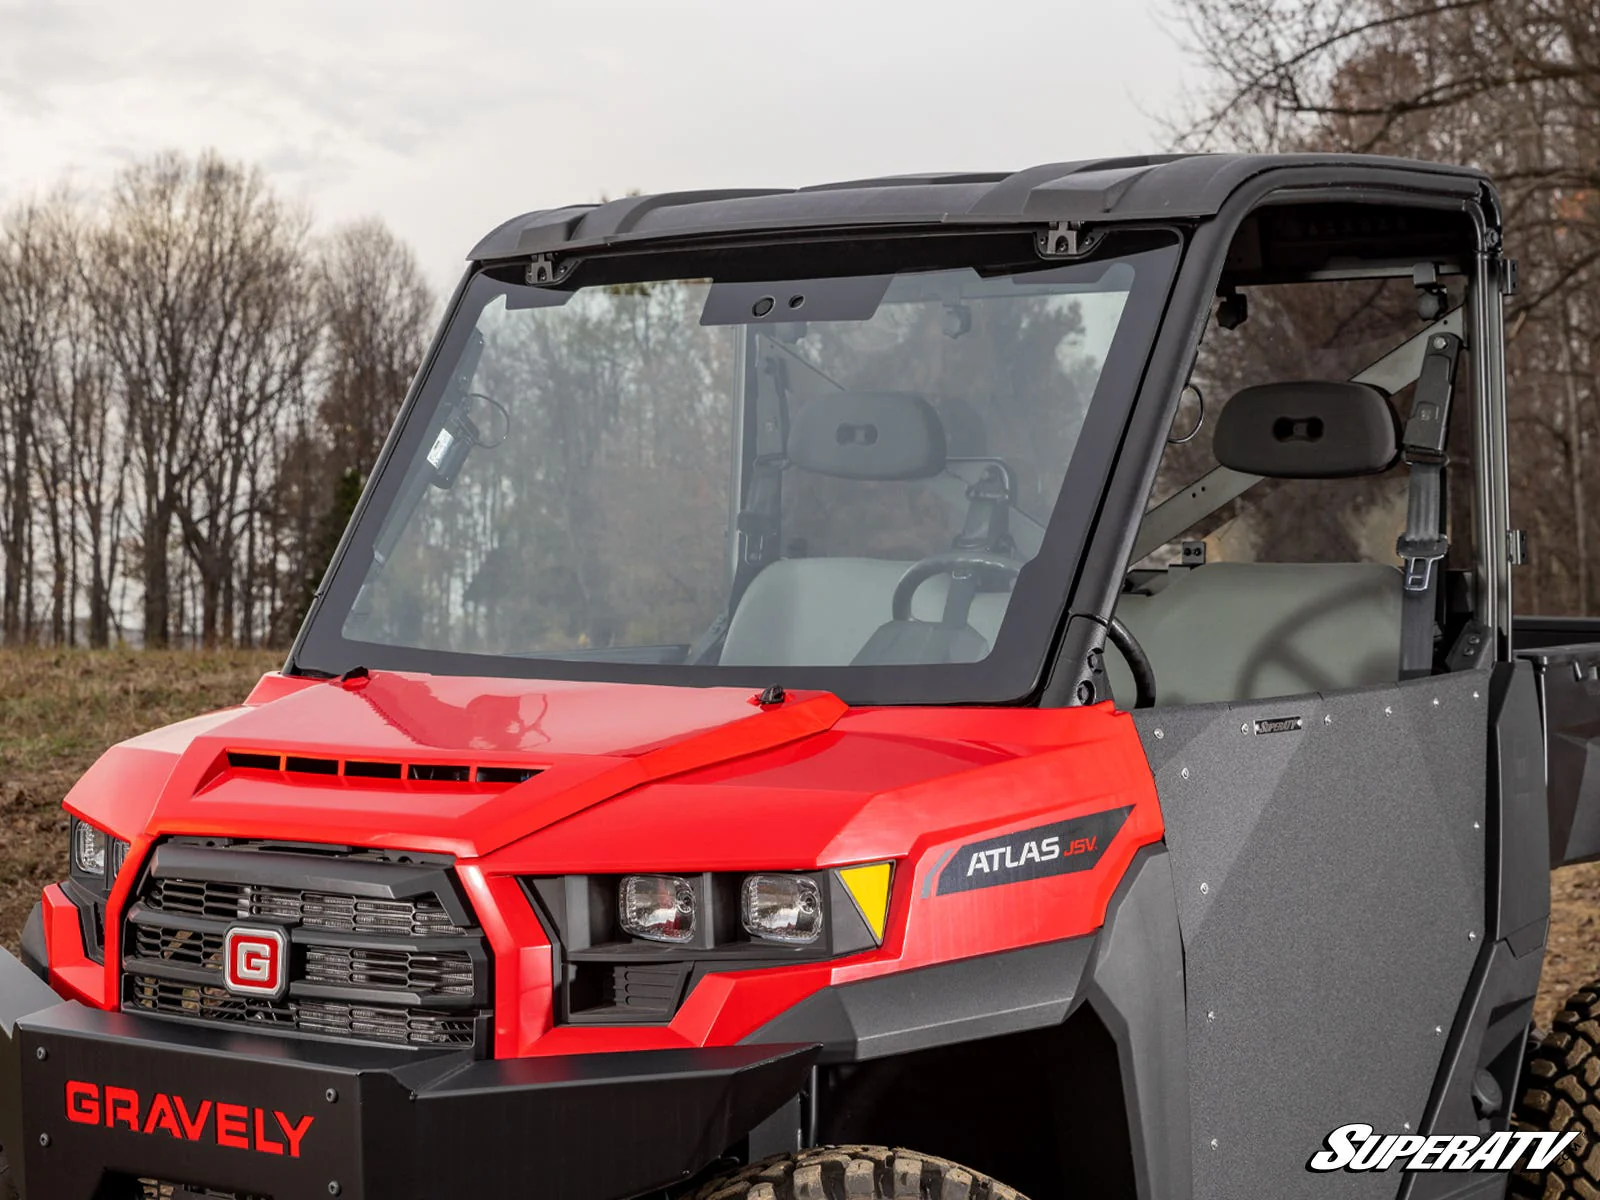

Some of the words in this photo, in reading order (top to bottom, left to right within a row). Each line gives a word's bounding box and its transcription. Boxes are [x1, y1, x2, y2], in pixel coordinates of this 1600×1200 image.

[966, 836, 1060, 877] ATLAS
[1063, 835, 1097, 857] JSV
[237, 941, 271, 982] G
[65, 1079, 315, 1158] GRAVELY
